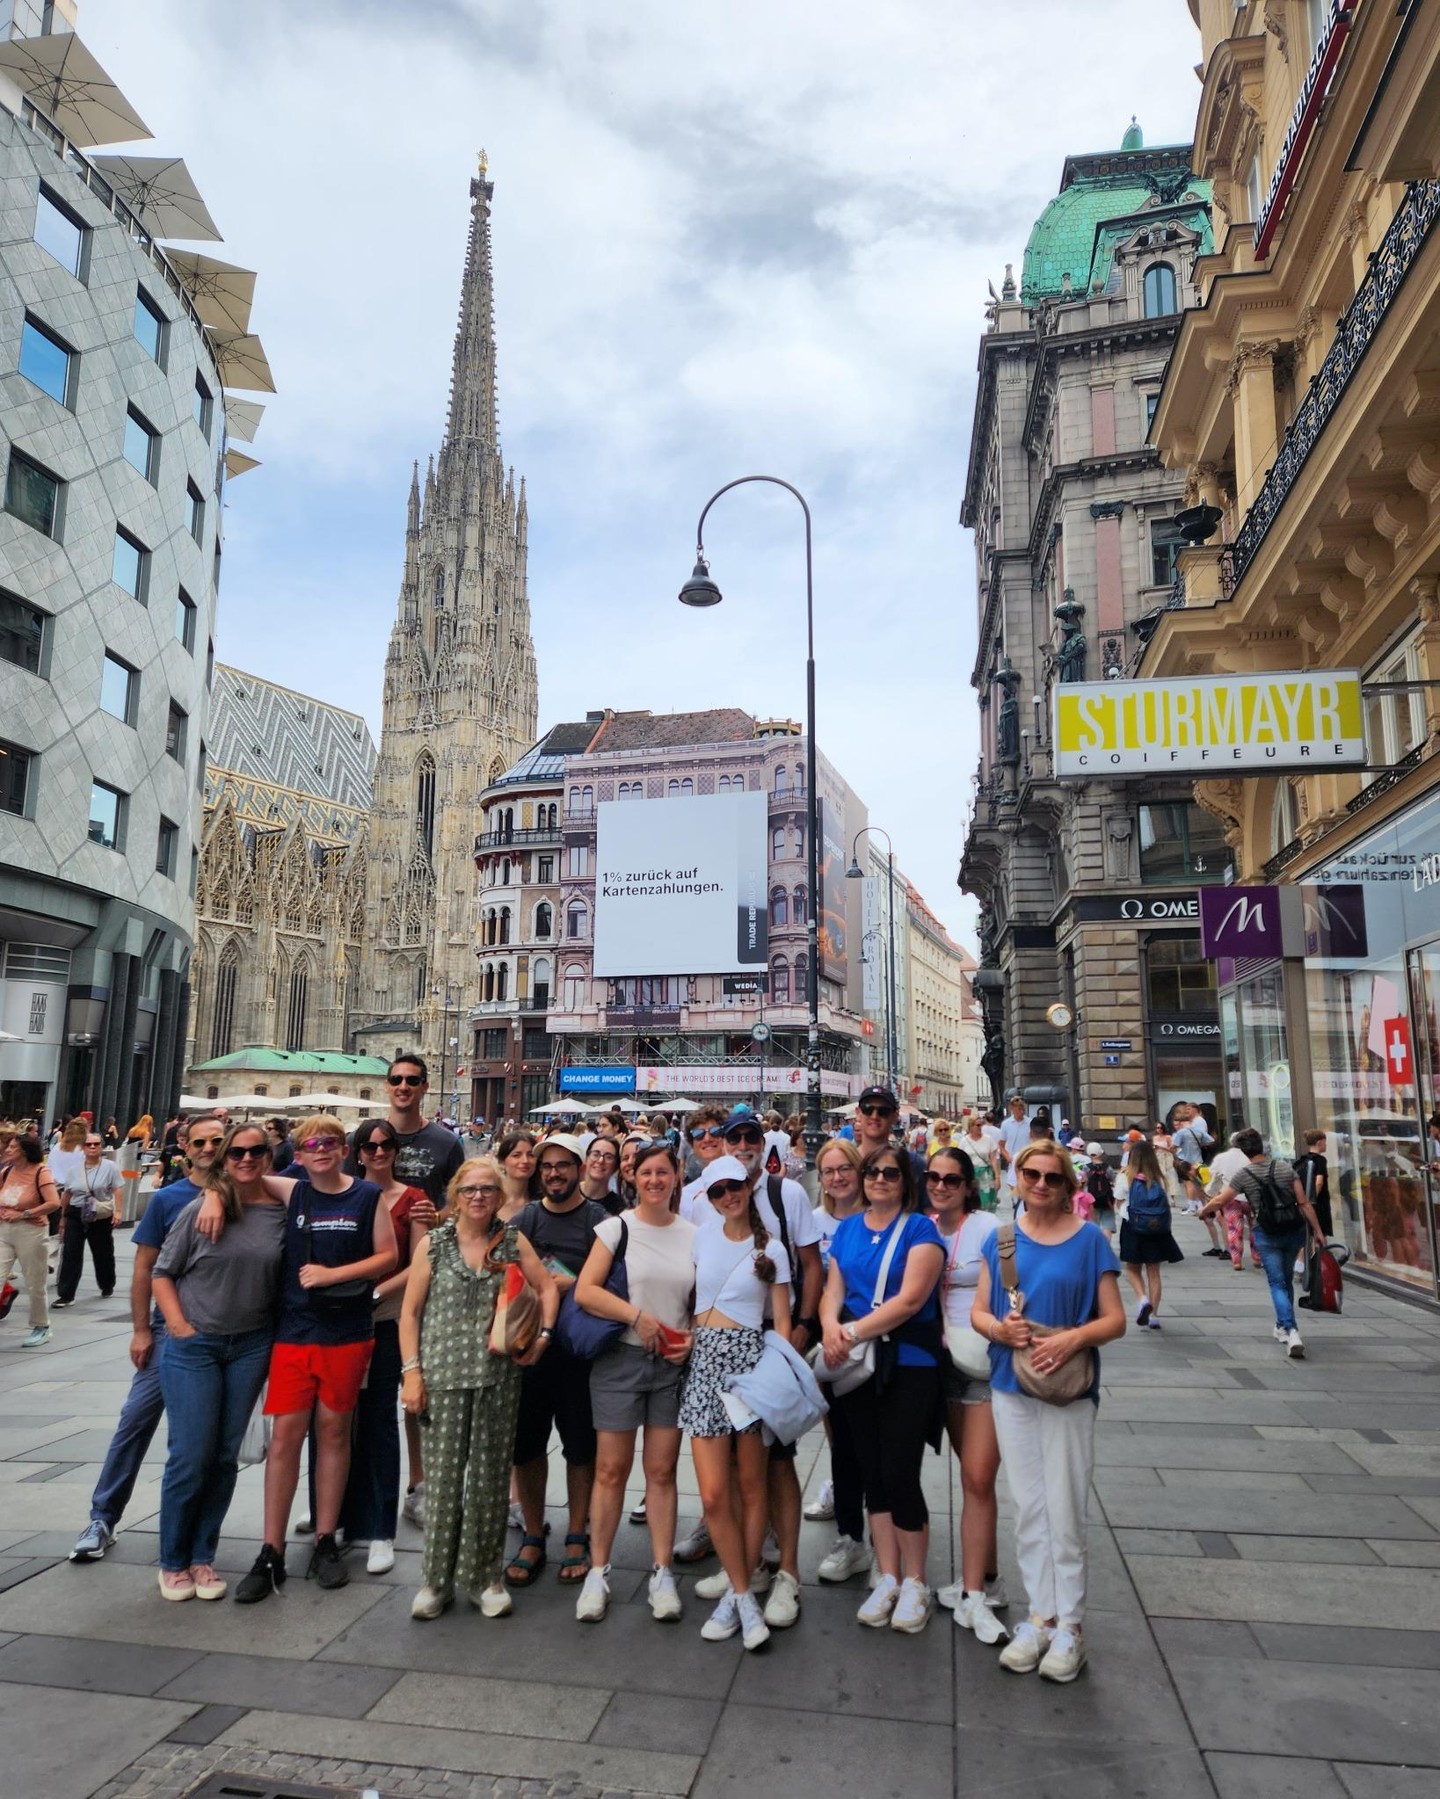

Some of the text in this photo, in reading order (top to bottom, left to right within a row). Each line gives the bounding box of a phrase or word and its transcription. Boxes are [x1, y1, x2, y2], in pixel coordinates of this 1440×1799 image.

[1078, 680, 1342, 751] STURMAYR
[1079, 744, 1343, 765] COIFFEURE
[602, 867, 698, 883] 1% zurück auf
[602, 883, 724, 897] Kartenzahlungen.
[866, 881, 874, 927] HOTEL
[1151, 901, 1198, 917] OME
[867, 945, 875, 992] ROYAL
[1177, 1025, 1221, 1034] OMEGA
[563, 1075, 632, 1083] CHANGE MONEY
[666, 1075, 679, 1083] THE
[717, 1075, 734, 1083] BEST
[737, 1075, 750, 1083] ICE
